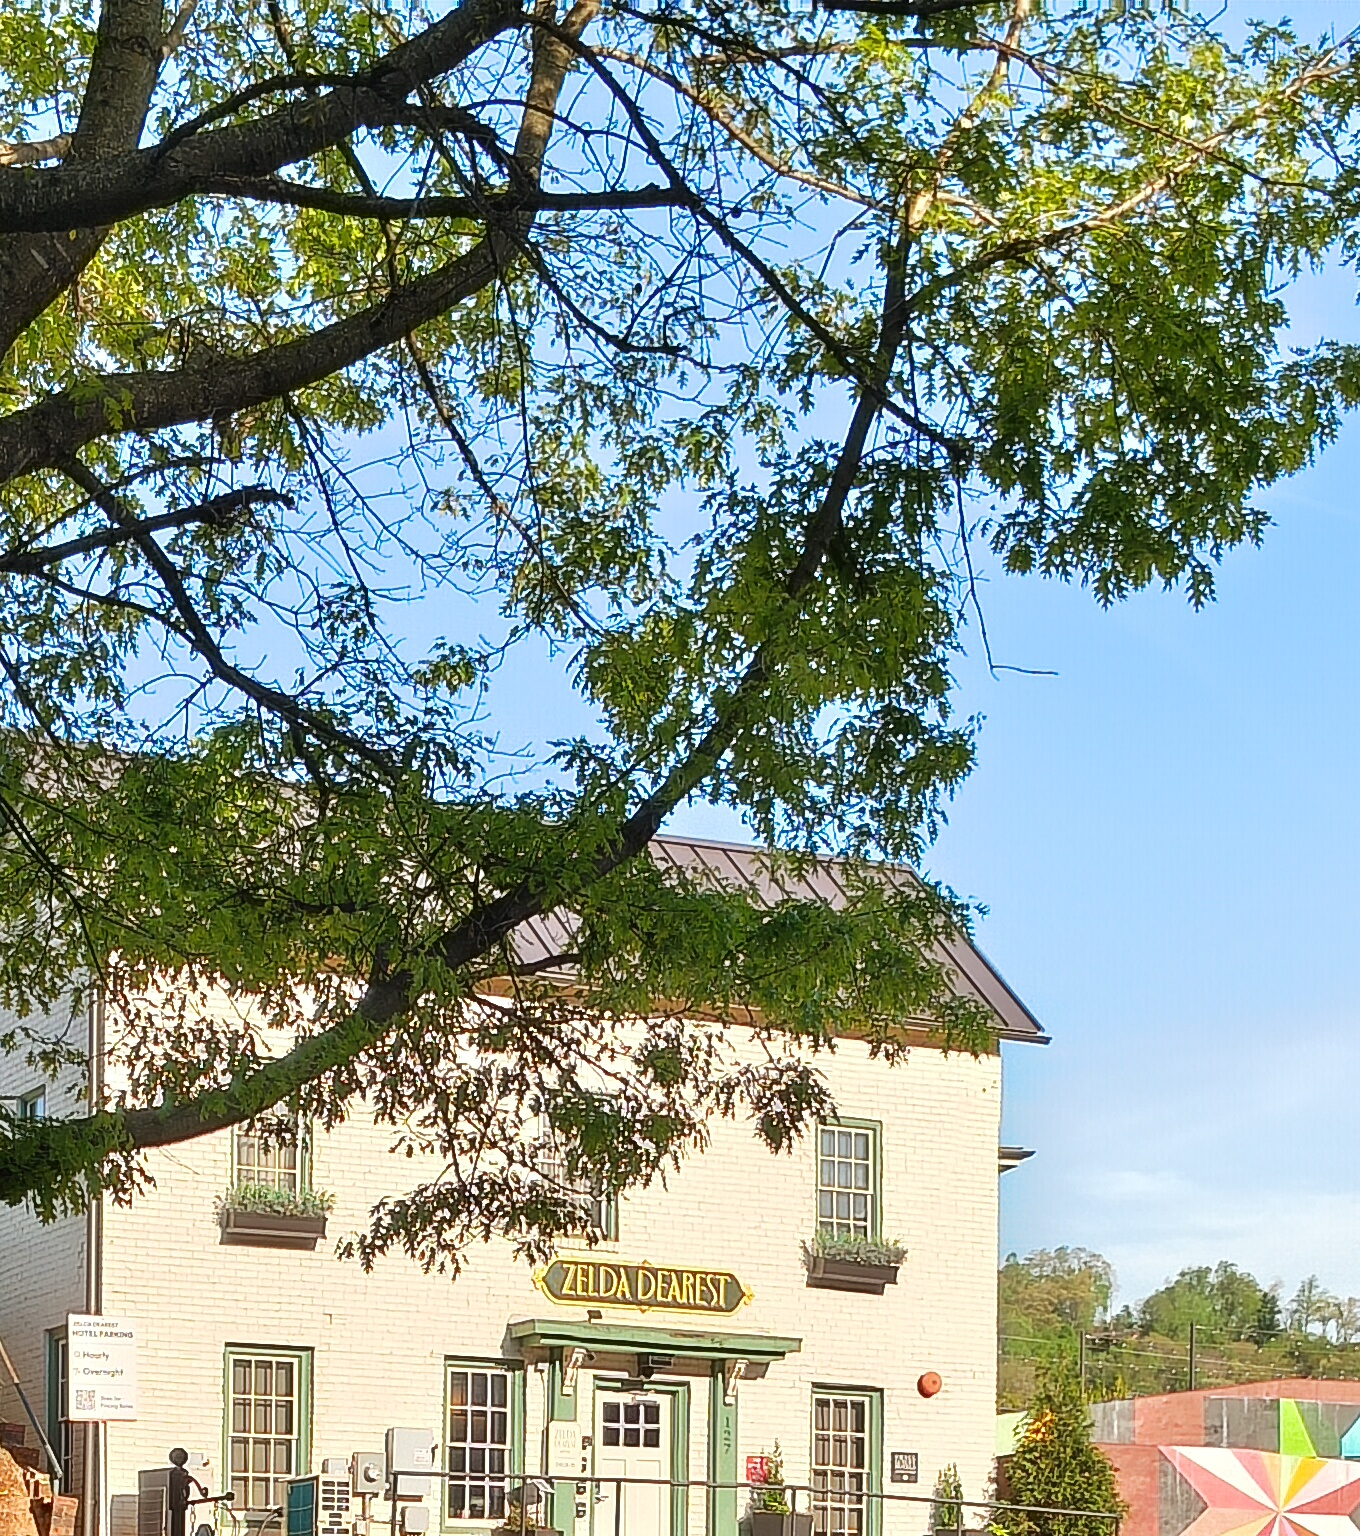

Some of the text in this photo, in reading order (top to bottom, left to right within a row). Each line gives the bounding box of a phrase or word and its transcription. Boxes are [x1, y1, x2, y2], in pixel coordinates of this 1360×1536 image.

[561, 1263, 732, 1309] ZELDA DEAREST
[72, 1330, 134, 1339] HOTEL PARKING
[83, 1351, 109, 1361] Hourly
[83, 1367, 124, 1378] Overnight
[723, 1416, 731, 1454] 127
